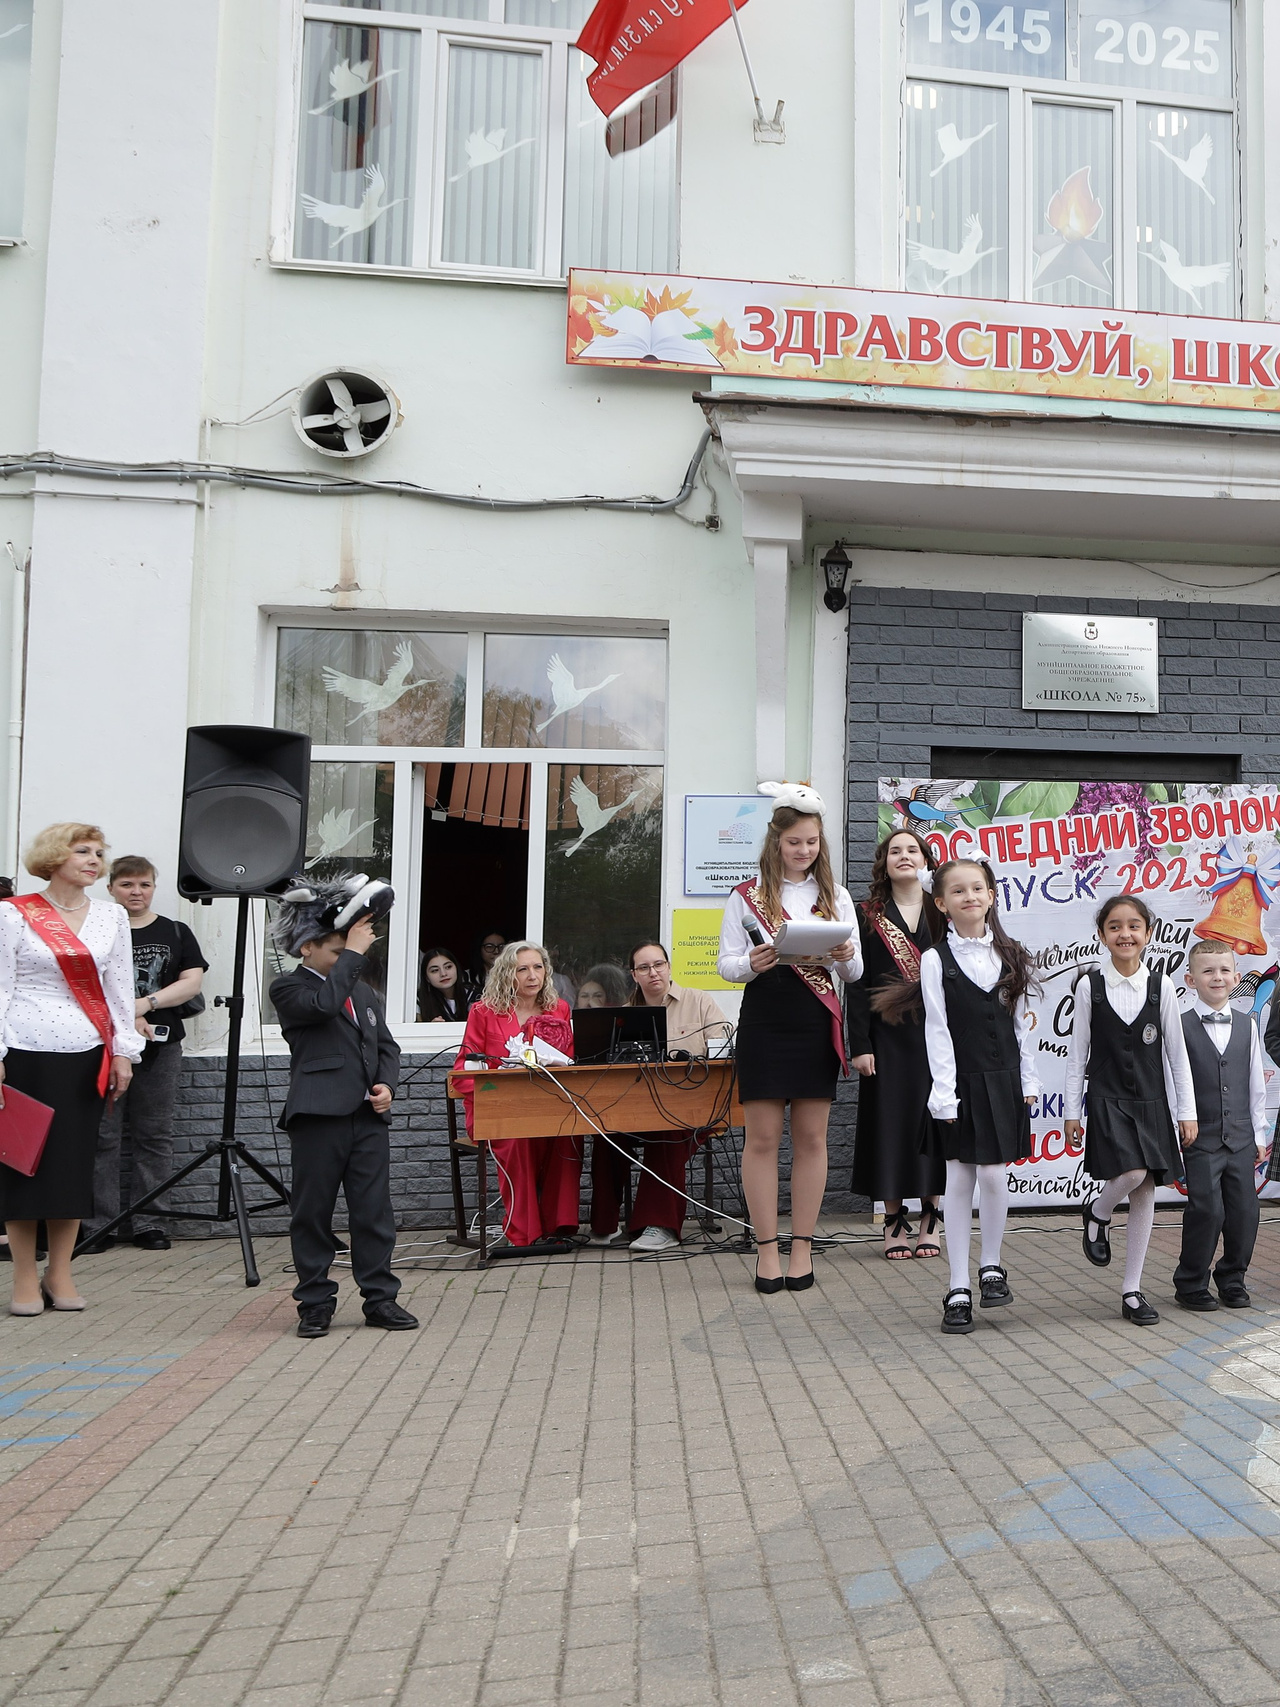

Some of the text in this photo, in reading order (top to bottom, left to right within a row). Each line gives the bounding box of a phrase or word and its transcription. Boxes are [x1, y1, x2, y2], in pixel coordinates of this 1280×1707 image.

[914, 0, 1051, 54] 1945
[1094, 19, 1220, 74] 2025
[740, 305, 1150, 386] ЗДРАВСТВУЙ,
[1049, 669, 1134, 678] ОБЩЕОБРАЗОВАТЕЛЬНОЕ
[1100, 663, 1146, 671] БЮДЖЕТНОЕ
[1035, 688, 1147, 704] «ШКОЛА № 75»
[925, 806, 1138, 868] ОСЛЕДНИЙ
[704, 873, 740, 881] «Школа
[995, 852, 1220, 912] ПУСК 2025
